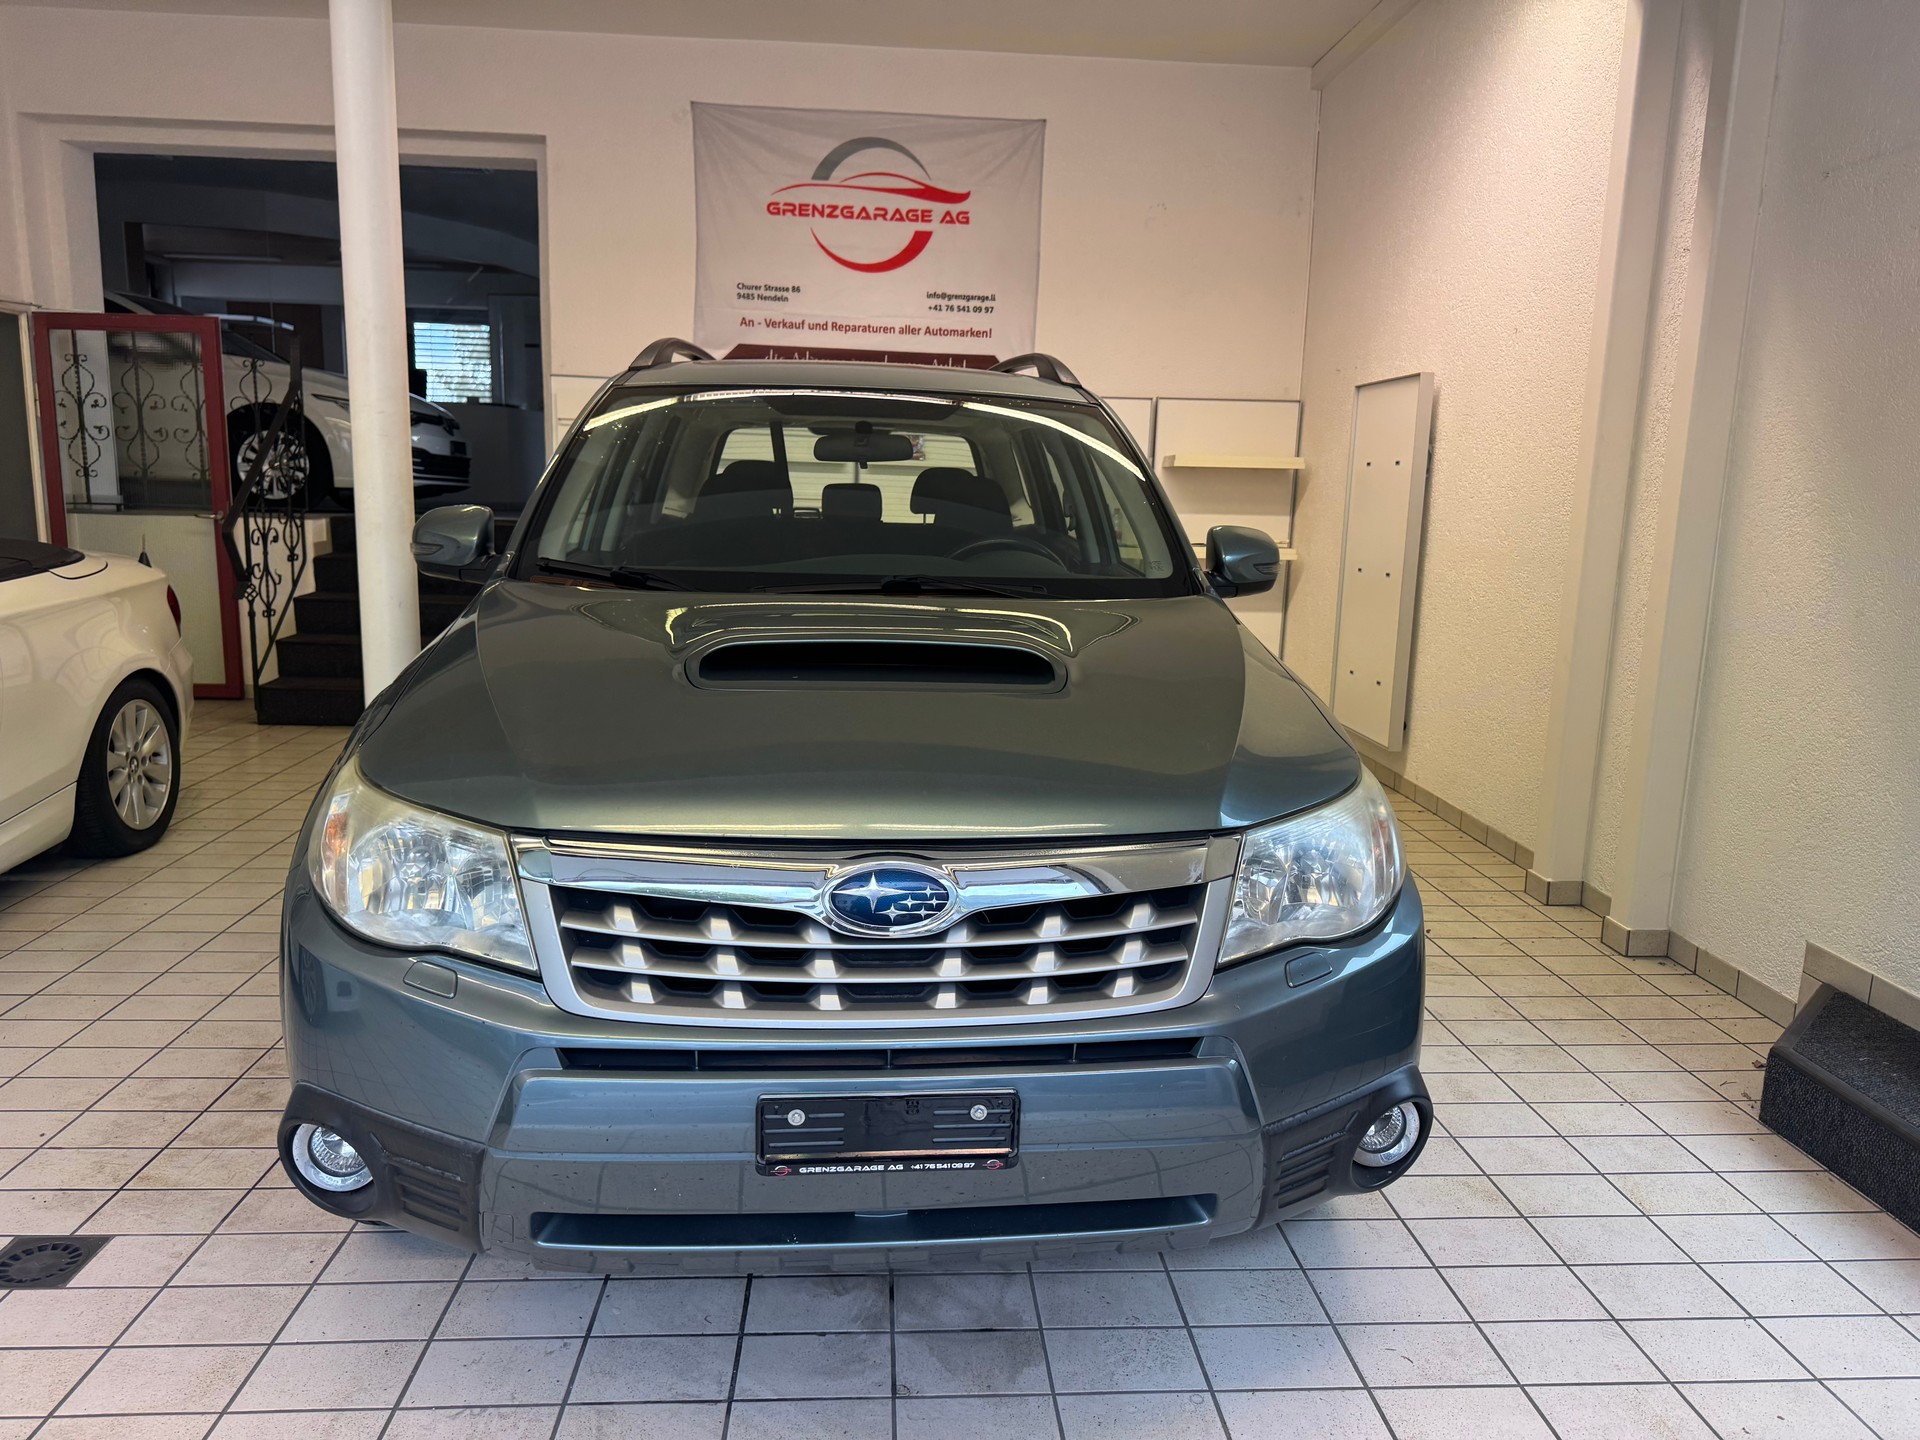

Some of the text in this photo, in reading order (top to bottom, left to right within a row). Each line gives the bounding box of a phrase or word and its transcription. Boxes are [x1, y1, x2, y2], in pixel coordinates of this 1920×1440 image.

[766, 202, 970, 225] GRENZGARAGE AG
[736, 282, 762, 291] Churer
[763, 284, 790, 293] Strasse
[756, 293, 789, 302] Nendeln
[926, 291, 996, 303] info@grenzgarage.li
[928, 304, 994, 314] +41 76 541 09 97
[739, 317, 754, 328] An
[764, 318, 806, 330] Verkauf
[808, 321, 828, 331] und
[831, 321, 896, 334] Reparaturen
[898, 324, 921, 336] aller
[924, 326, 992, 339] Automarken!
[799, 1164, 884, 1173] GRENZGARAGE
